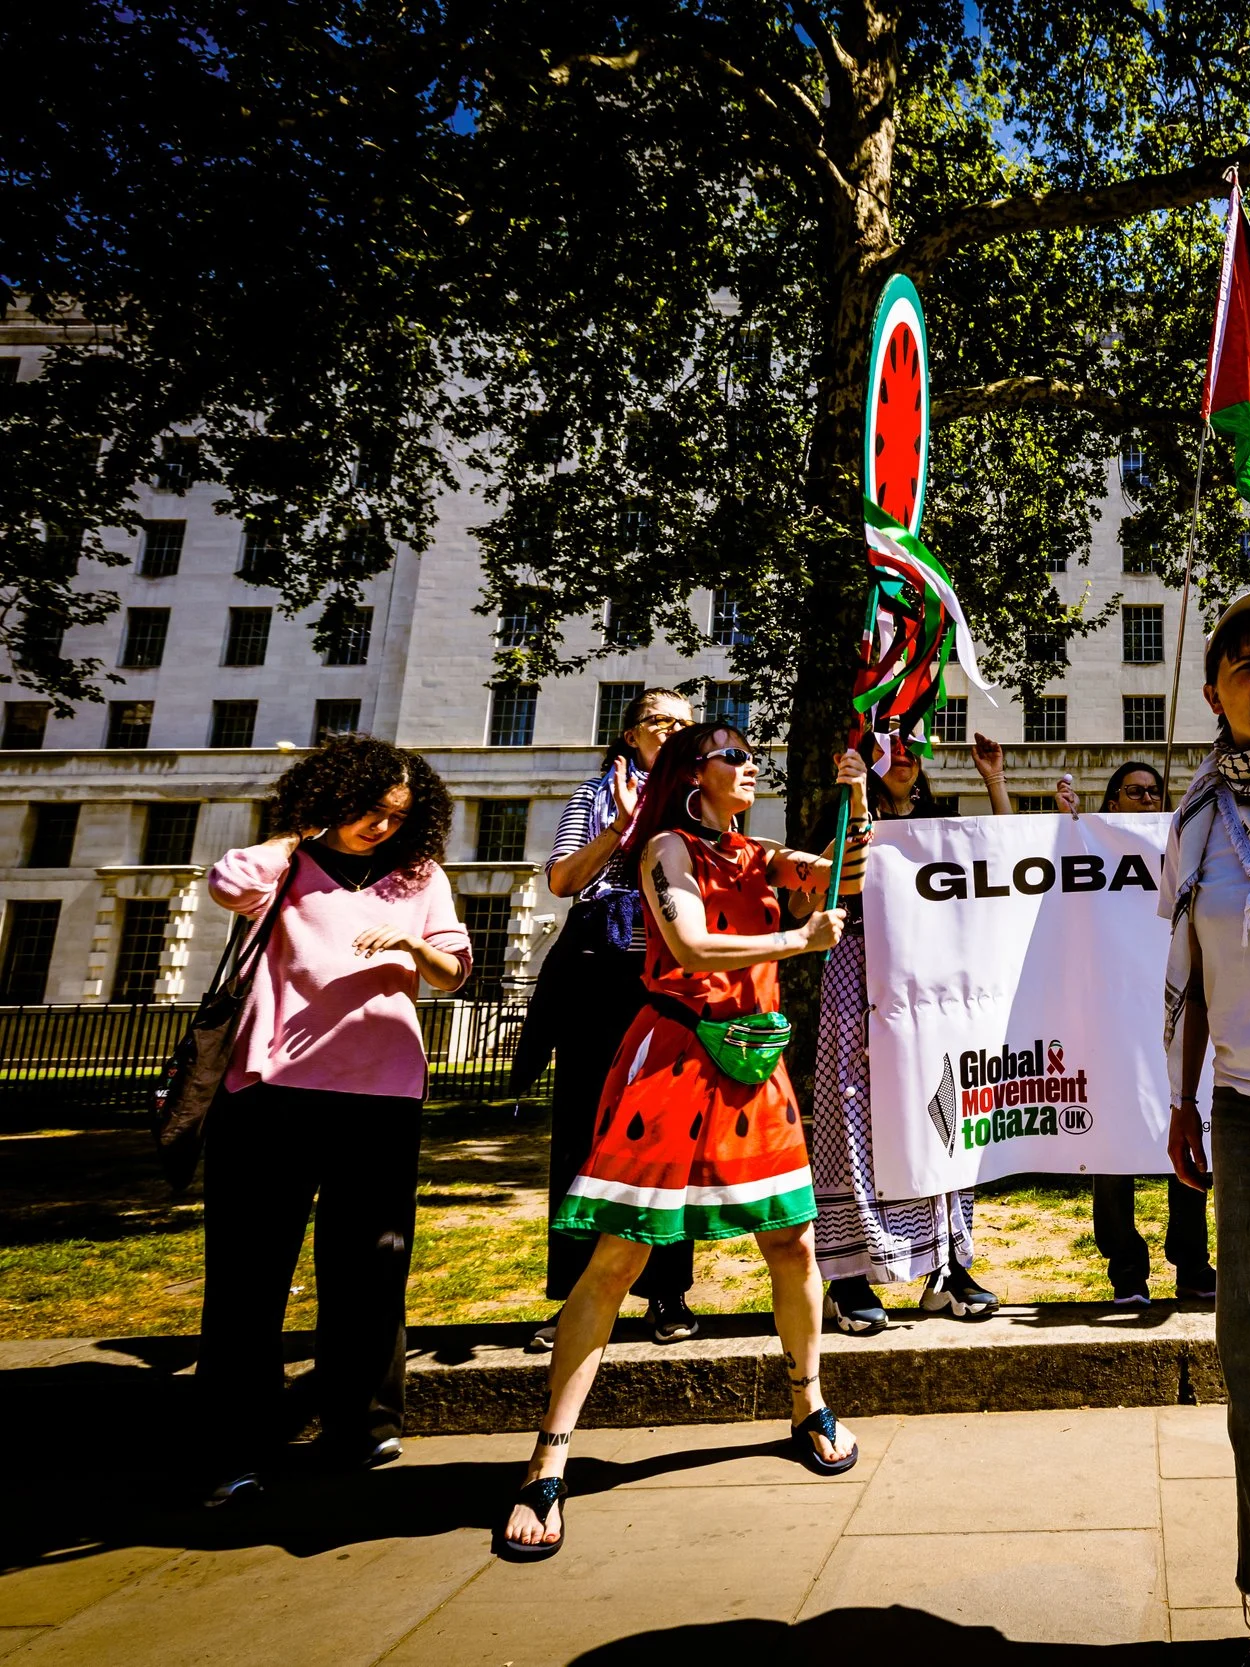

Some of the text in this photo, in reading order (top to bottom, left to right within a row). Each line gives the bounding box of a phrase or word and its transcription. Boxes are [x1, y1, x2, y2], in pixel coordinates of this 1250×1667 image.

[915, 854, 1167, 901] GLOBA
[959, 1039, 1044, 1090] Global
[1064, 1110, 1087, 1130] UK
